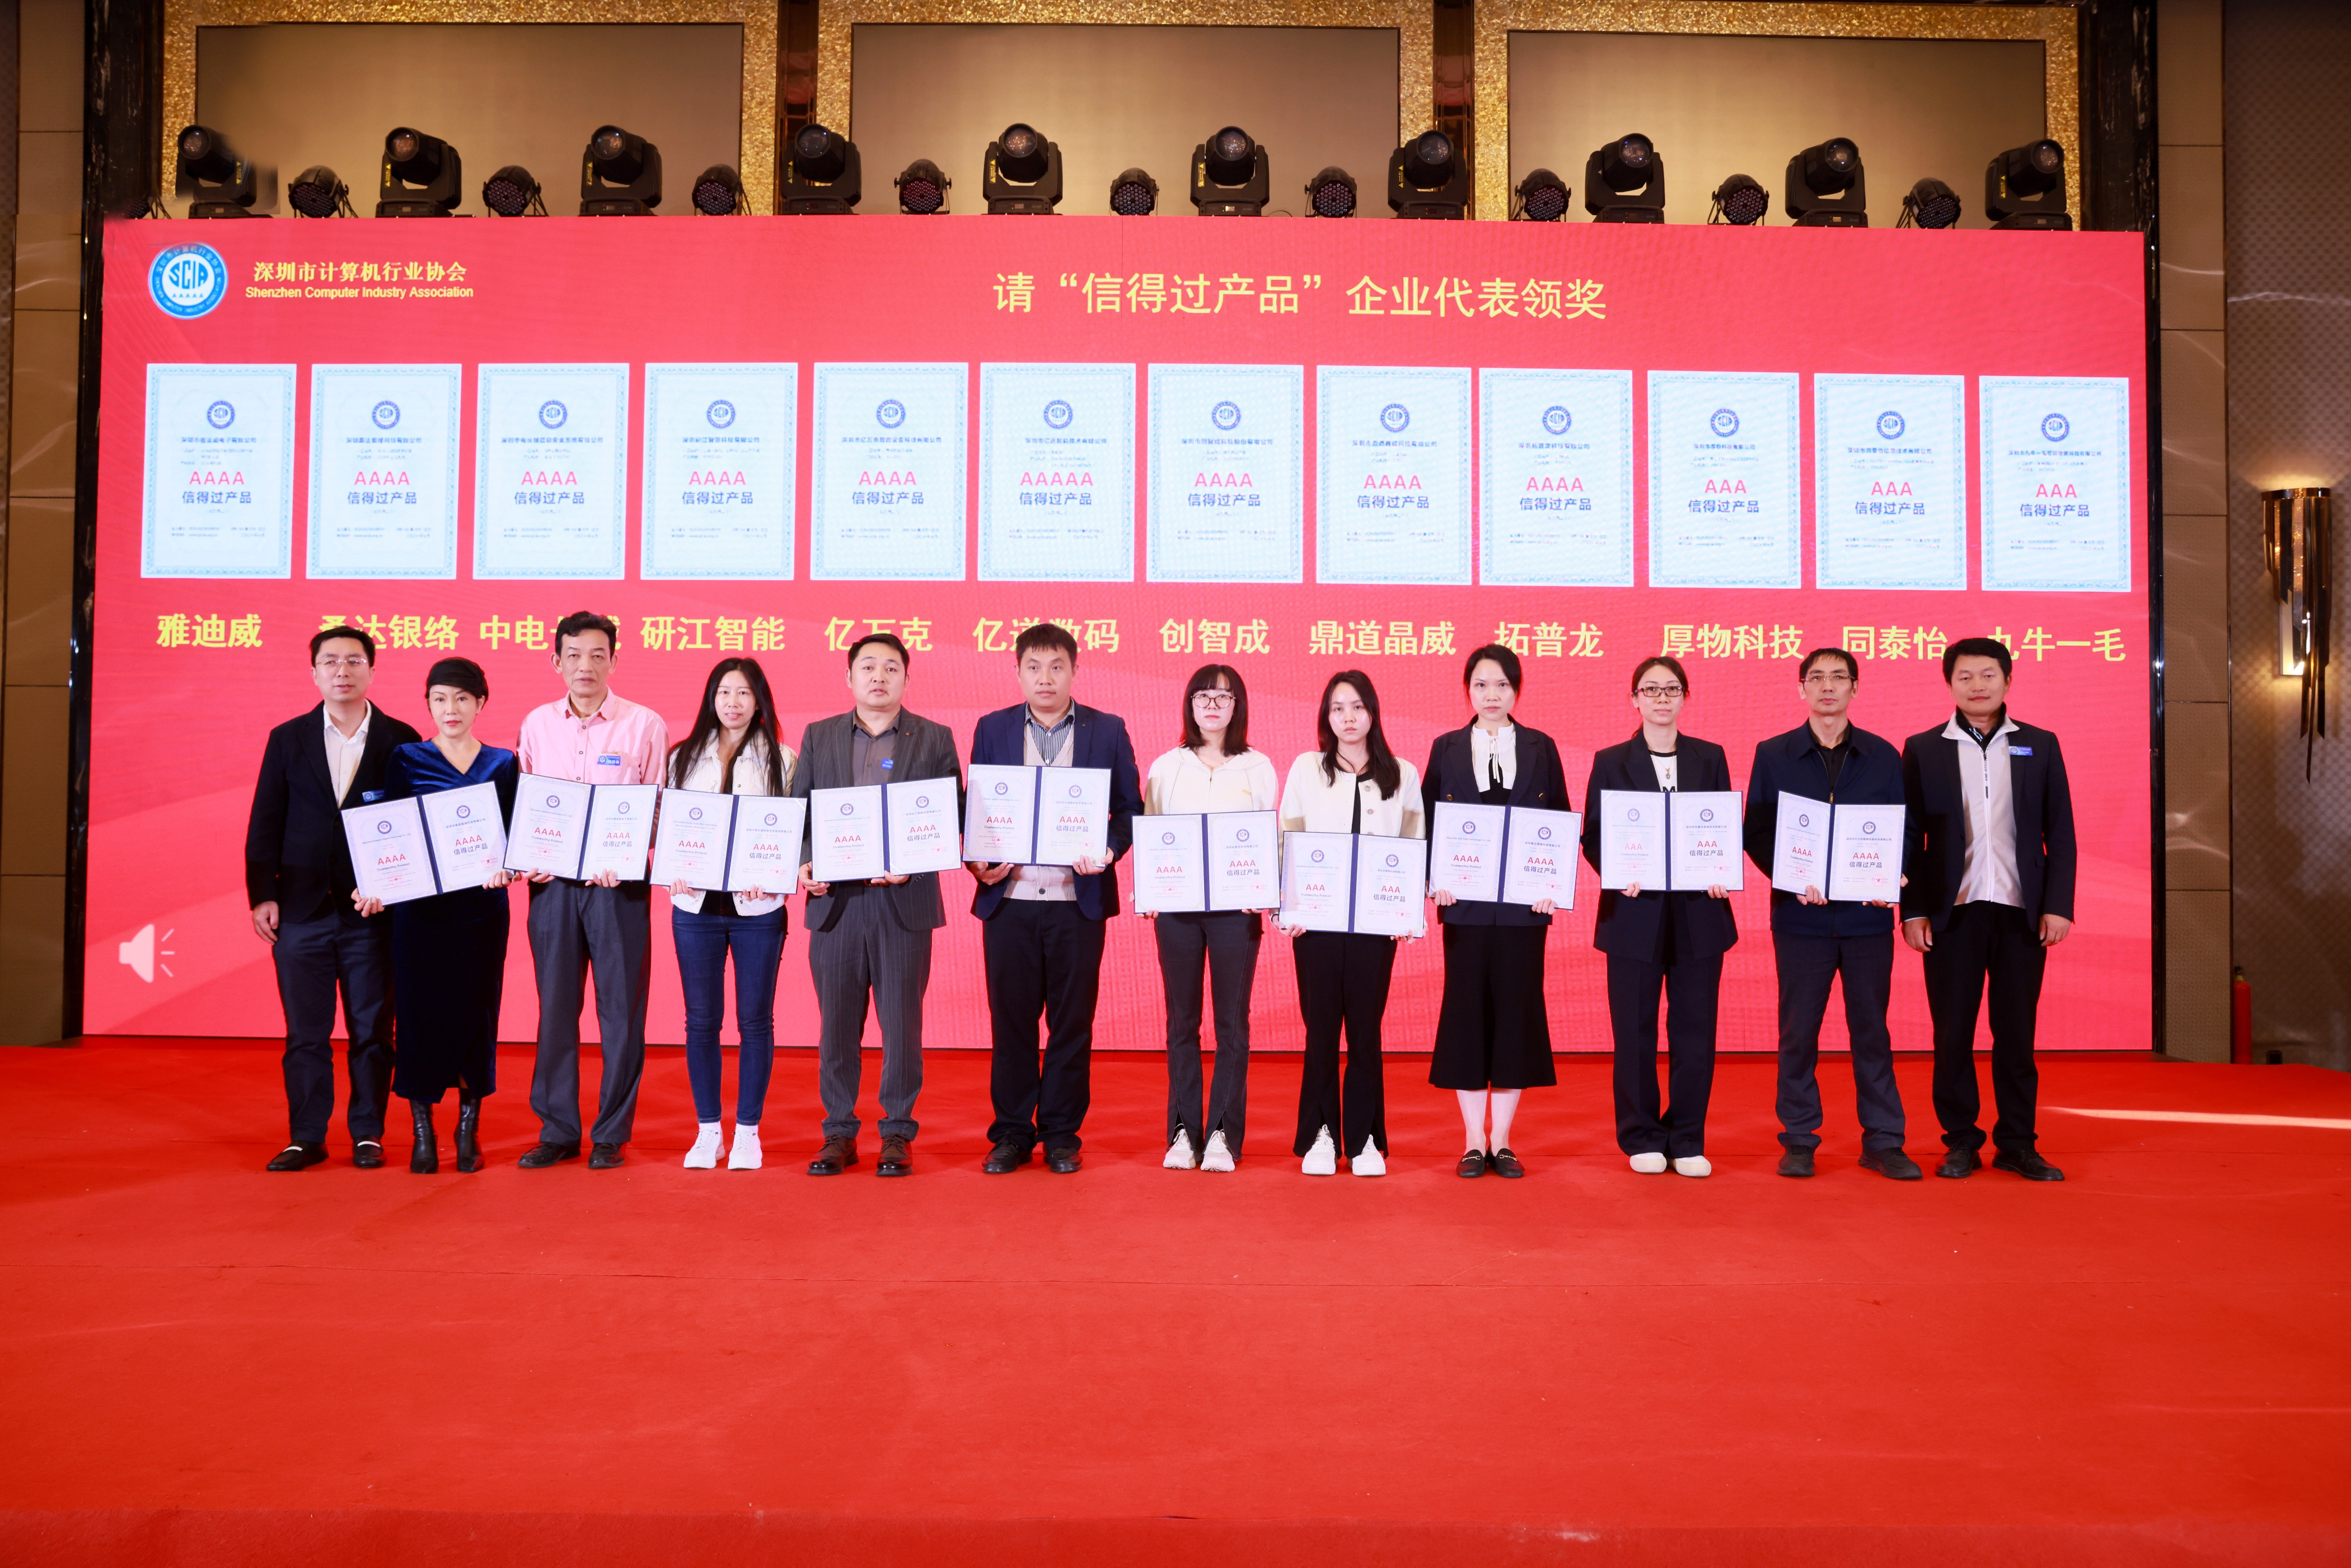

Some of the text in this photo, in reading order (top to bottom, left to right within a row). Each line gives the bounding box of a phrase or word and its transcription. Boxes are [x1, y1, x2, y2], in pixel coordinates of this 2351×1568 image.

[168, 260, 208, 289] SCIA
[254, 261, 466, 282] 深圳市计算机行业协会
[245, 286, 474, 299] Shenzhen Computer Industry Association
[189, 471, 245, 485] AAAA
[354, 471, 410, 485] AAAA
[522, 471, 577, 485] AAAA
[689, 471, 746, 485] AAAA
[859, 471, 916, 485] AAAA
[1020, 472, 1093, 486] AAAAA
[1195, 472, 1253, 488] AAAA
[1364, 475, 1422, 489] AAAA
[1526, 476, 1584, 492] AAAA
[1704, 479, 1746, 494] AAA
[1871, 481, 1913, 496] AAA
[2036, 484, 2077, 498] AAA
[183, 492, 251, 503] 信得过产品
[348, 492, 416, 504] 信得过产品
[514, 492, 584, 504] 信得过产品
[682, 492, 753, 504] 信得过产品
[852, 492, 924, 504] 信得过产品
[1019, 493, 1092, 505] 信得过产品
[1188, 494, 1261, 506] 信得过产品
[1357, 495, 1429, 508] 信得过产品
[1520, 498, 1591, 510] 信得过产品
[1688, 500, 1759, 512] 信得过产品
[1855, 502, 1925, 514] 信得过产品
[2020, 504, 2090, 516] 信得过产品
[157, 614, 263, 648] 雅迪威
[480, 615, 621, 650] 中电
[640, 616, 785, 651] 研江智能
[1161, 619, 1270, 653] 创智成
[1312, 620, 1456, 655] 鼎道晶威
[1494, 621, 1604, 657] 拓普龙
[1661, 624, 1804, 659] 厚物科技
[1843, 626, 1948, 659] 同泰怡
[986, 816, 1013, 824] AAAA
[534, 827, 561, 837] AAAA
[910, 824, 936, 833] AAAA
[455, 835, 483, 846] AAAA
[834, 835, 861, 843] AAAA
[907, 832, 940, 841] 信得过产品
[453, 843, 488, 855] 信得过产品
[678, 840, 706, 849] AAAA
[1792, 846, 1812, 858] AAAA
[377, 853, 406, 865] AAAA
[1527, 856, 1554, 866] AAAA
[1524, 865, 1557, 874] 信得过产品
[1381, 885, 1401, 893] AAA
[1374, 894, 1406, 902] 信得过产品
